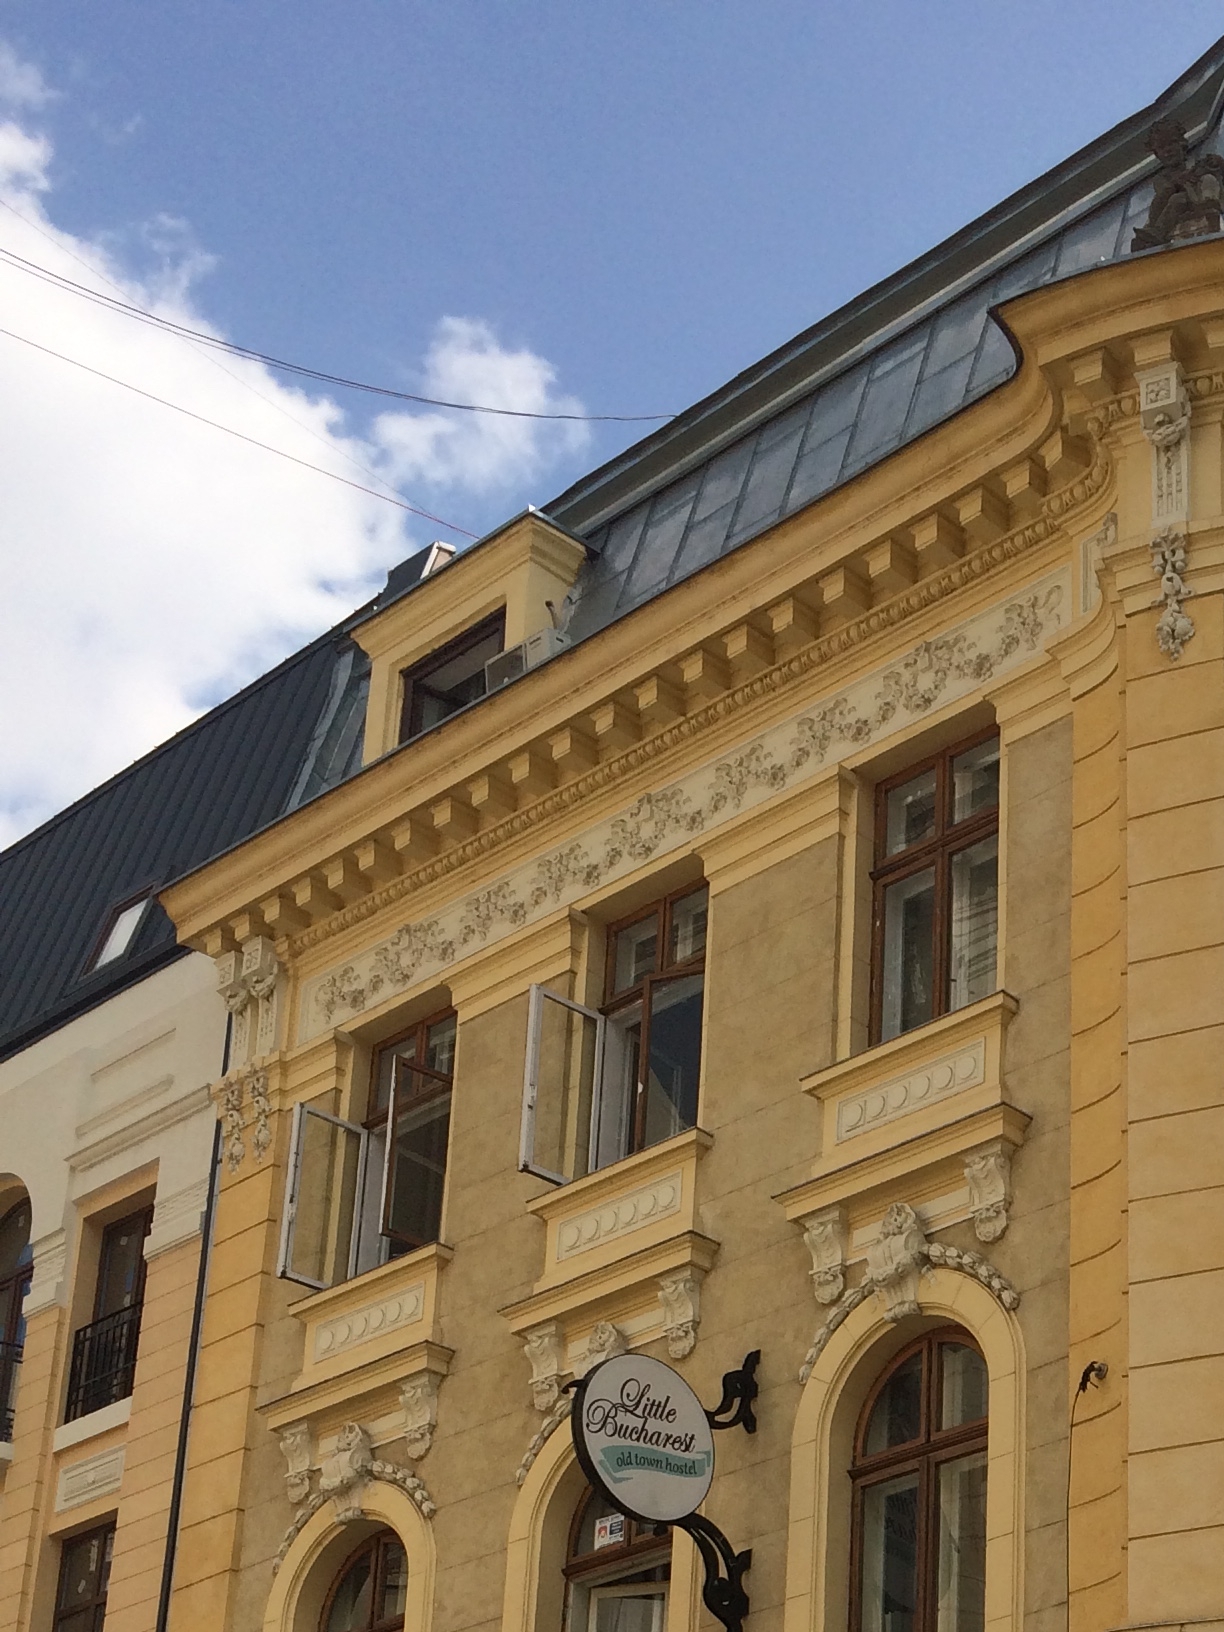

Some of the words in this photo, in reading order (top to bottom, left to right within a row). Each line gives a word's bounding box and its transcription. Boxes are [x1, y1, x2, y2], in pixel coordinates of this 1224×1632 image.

[613, 1378, 678, 1424] Little
[586, 1398, 697, 1453] Bucharest
[616, 1451, 633, 1468] old
[634, 1453, 663, 1470] town
[665, 1456, 698, 1475] hostel
